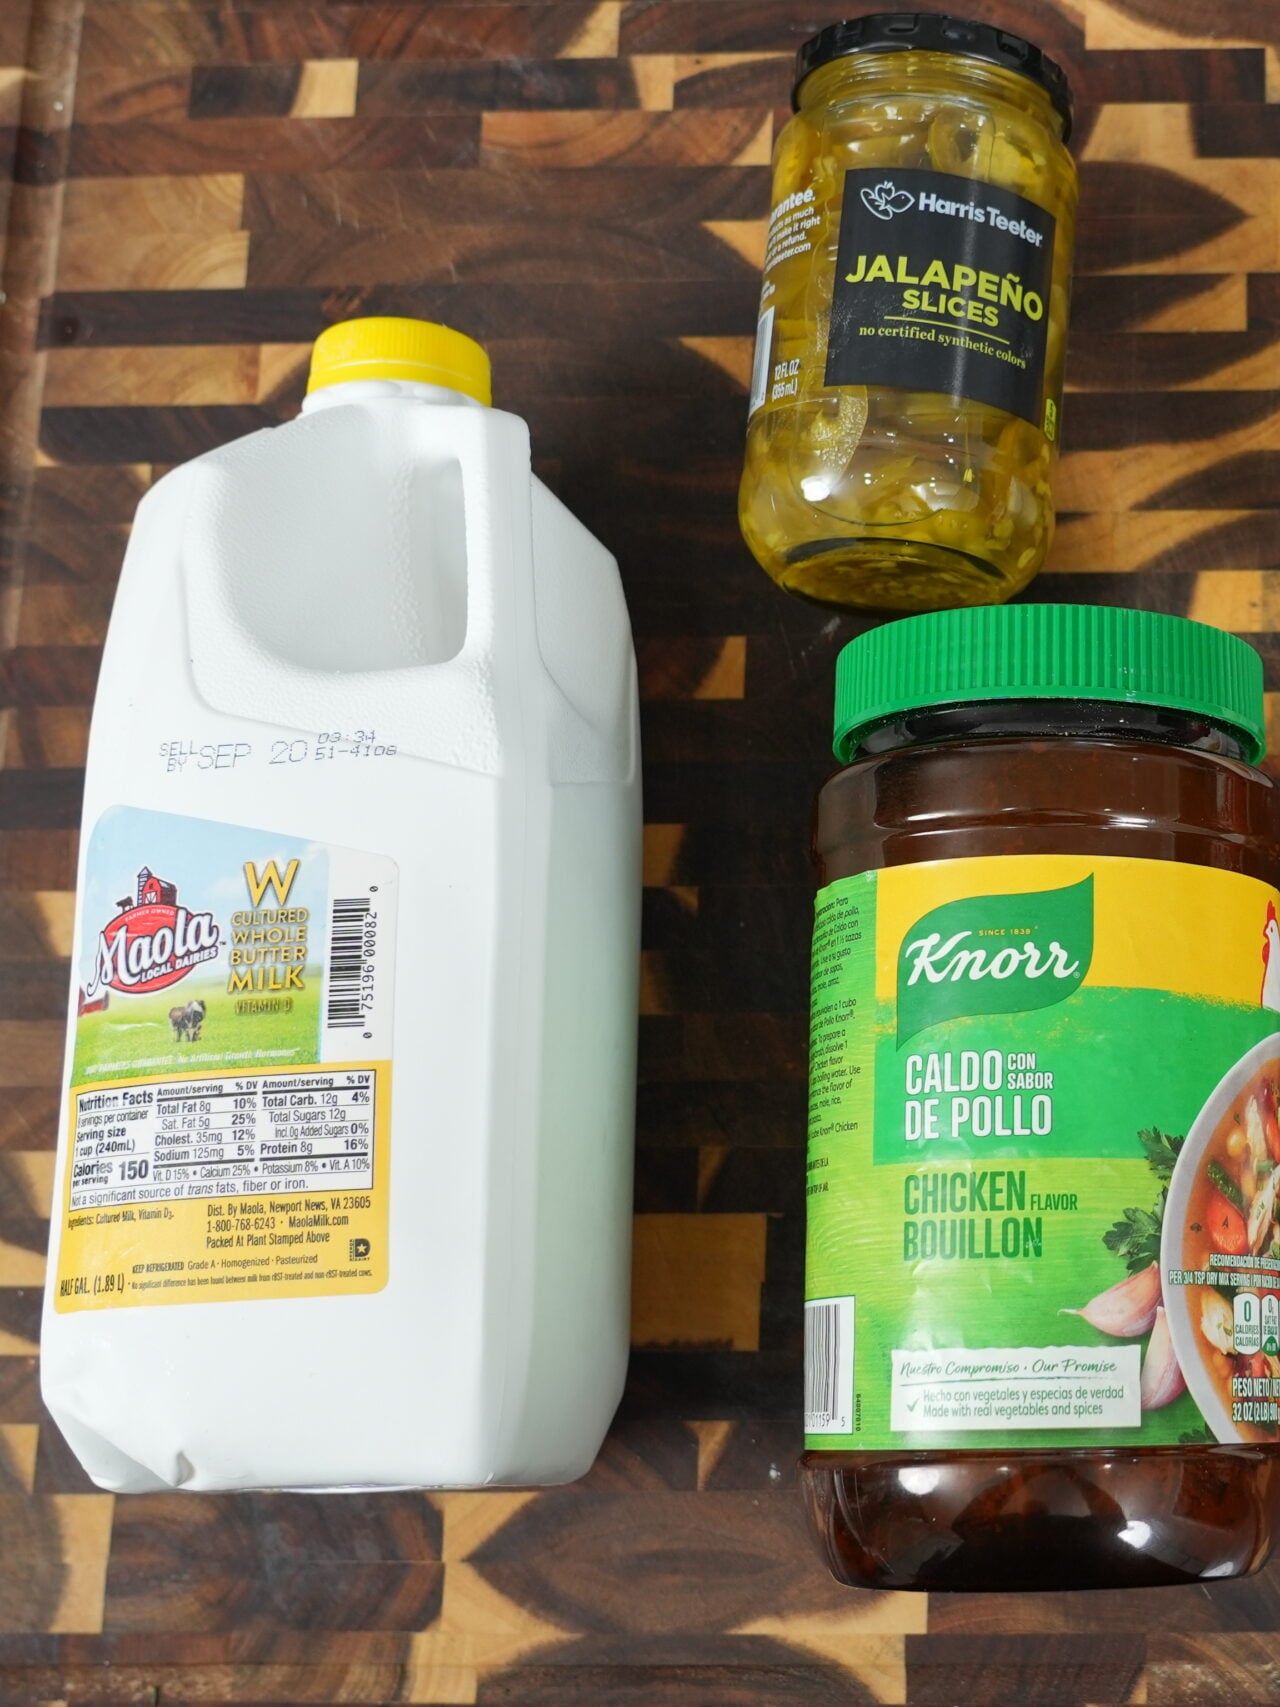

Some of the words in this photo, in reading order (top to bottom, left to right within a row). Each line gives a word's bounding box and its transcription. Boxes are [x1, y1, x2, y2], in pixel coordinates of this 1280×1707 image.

[918, 192, 986, 223] Harris
[987, 206, 1043, 248] Teeter
[845, 255, 1044, 321] JALAPEÑO
[902, 289, 999, 328] SLICES
[859, 327, 875, 336] no
[878, 326, 936, 342] certified
[938, 332, 994, 356] synthetic
[996, 347, 1027, 370] colors
[790, 358, 800, 376] OZ
[786, 378, 798, 396] mL)
[160, 740, 198, 757] SELL
[197, 743, 252, 770] SEP
[269, 740, 308, 765] 20
[167, 757, 188, 772] BY
[243, 859, 300, 908] W
[232, 908, 308, 927] CULTURED
[232, 926, 308, 945] WHOLE
[363, 912, 378, 957] 00082
[978, 928, 1006, 937] SINCE
[1010, 928, 1032, 936] 1838
[87, 906, 220, 998] Maola
[230, 946, 306, 966] BUTTER
[905, 930, 1080, 986] Knorr
[141, 962, 174, 984] LOCAL
[176, 946, 218, 968] DAIRIES
[228, 965, 305, 993] MILK
[361, 964, 376, 1010] 75196
[262, 1077, 334, 1090] Amount/serving
[346, 1075, 356, 1084] %
[358, 1074, 370, 1084] DV
[905, 1049, 1004, 1096] CALDO
[1007, 1052, 1037, 1071] CON
[1007, 1072, 1054, 1090] SABOR
[157, 1084, 224, 1096] Amount/serving
[262, 1095, 287, 1108] Total
[290, 1094, 318, 1106] Carb.
[321, 1092, 338, 1106] 12g
[352, 1091, 370, 1103] 4%
[79, 1095, 118, 1113] Nutrition
[122, 1090, 154, 1106] Facts
[156, 1102, 180, 1116] Total
[182, 1101, 197, 1114] Fat
[199, 1100, 212, 1114] 8g
[234, 1098, 257, 1110] 10%
[269, 1110, 291, 1123] Total
[293, 1109, 326, 1124] Sugars
[329, 1108, 346, 1121] 12g
[904, 1098, 940, 1141] DE
[951, 1094, 1054, 1138] POLLO
[76, 1128, 104, 1144] Serving
[108, 1126, 126, 1138] size
[834, 1121, 858, 1133] Chicken
[154, 1132, 194, 1147] Cholest.
[196, 1131, 223, 1144] 35mg
[232, 1128, 256, 1141] 12%
[260, 1142, 298, 1155] Protein
[300, 1140, 313, 1155] 8g
[344, 1138, 369, 1150] 16%
[154, 1149, 190, 1162] Sodium
[193, 1146, 224, 1160] 125mg
[237, 1144, 255, 1156] 5%
[74, 1160, 112, 1178] Calories
[119, 1159, 149, 1181] 150
[904, 1170, 1026, 1215] CHICKEN
[1030, 1193, 1078, 1212] FLAVOR
[208, 1204, 224, 1217] Dist.
[228, 1202, 237, 1218] By
[240, 1202, 266, 1216] Maola,
[270, 1200, 302, 1215] Newport
[304, 1199, 328, 1212] News,
[330, 1197, 341, 1210] VA
[343, 1196, 371, 1210] 23605
[206, 1217, 276, 1233] 1-800-768-6243
[288, 1214, 349, 1228] MaolaMilk.com
[206, 1234, 234, 1249] Packed
[236, 1234, 244, 1247] At
[246, 1233, 267, 1246] Plant
[269, 1232, 304, 1246] Stamped
[306, 1230, 330, 1244] Above
[904, 1217, 1042, 1262] BOUILLON
[188, 1260, 208, 1270] Grade
[210, 1260, 216, 1270] A
[221, 1256, 270, 1269] Homogenized
[276, 1253, 318, 1265] Pasteurized
[60, 1278, 74, 1296] HALF
[75, 1276, 90, 1294] GAL.
[94, 1273, 115, 1296] (1.89
[1169, 1270, 1182, 1284] PER
[1194, 1271, 1206, 1285] TSP
[1206, 1272, 1218, 1286] DRY
[1218, 1272, 1230, 1286] MIX
[1244, 1300, 1252, 1322] 0
[1235, 1324, 1260, 1335] CALORIES
[900, 1361, 942, 1378] Nuestro
[944, 1362, 1020, 1378] Compromiso
[1032, 1359, 1059, 1373] Our
[1061, 1358, 1117, 1373] Promise
[923, 1389, 952, 1402] Hecho
[954, 1391, 972, 1402] con
[973, 1388, 1020, 1406] vegetales
[1022, 1390, 1030, 1403] y
[1030, 1388, 1074, 1404] especias
[1076, 1386, 1088, 1400] de
[1090, 1386, 1124, 1400] verdad
[1232, 1377, 1253, 1398] PESO
[1254, 1377, 1270, 1398] NETO
[923, 1403, 950, 1418] Made
[952, 1403, 972, 1417] with
[974, 1402, 993, 1416] real
[994, 1401, 1049, 1420] vegetables
[1052, 1400, 1072, 1415] and
[1074, 1400, 1103, 1418] spices
[1232, 1402, 1242, 1422] 32
[1242, 1402, 1254, 1422] OZ
